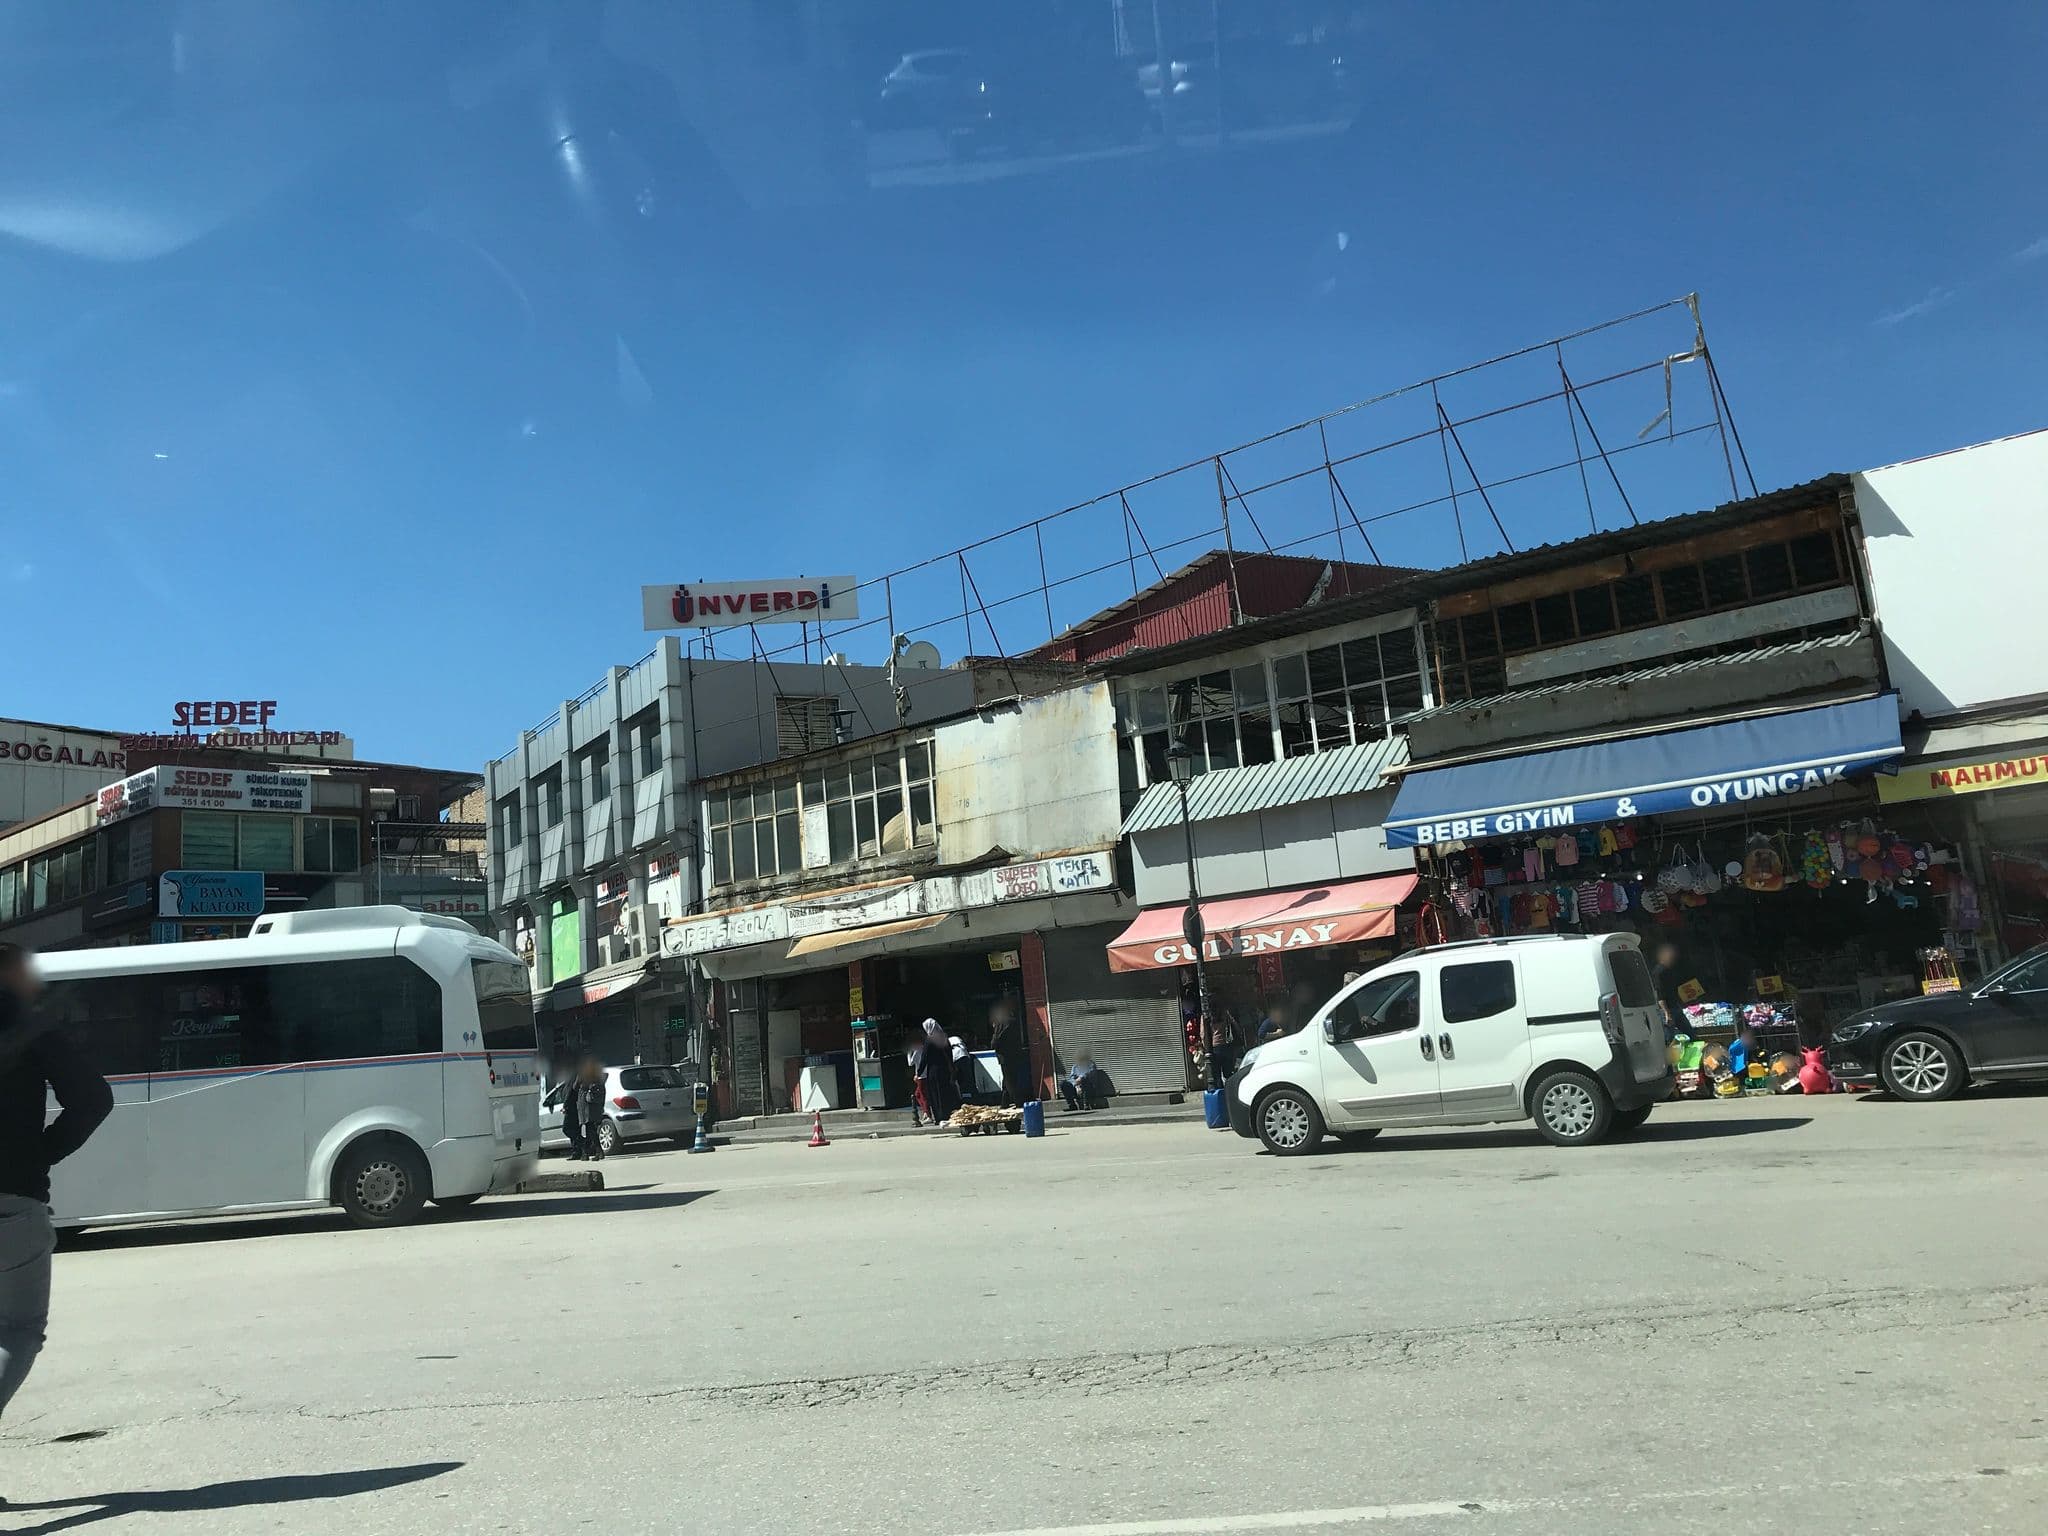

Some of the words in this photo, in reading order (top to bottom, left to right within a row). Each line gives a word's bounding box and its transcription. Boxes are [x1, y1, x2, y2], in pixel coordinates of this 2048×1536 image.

[172, 700, 278, 726] SEDEF
[119, 731, 199, 750] EĞİTİM
[206, 731, 340, 748] KURUMLARI
[174, 770, 233, 787] SEDEF
[246, 774, 279, 785] SÜRÜCÜ
[280, 776, 308, 786] KURSU
[164, 786, 199, 798] EĞİTİM
[201, 788, 243, 800] KURUMU
[250, 786, 303, 798] PSİKOTEKNİK
[181, 798, 197, 806] 351
[200, 799, 211, 807] 41
[1417, 818, 1488, 845] BEBE
[1616, 796, 1638, 817] &
[1691, 765, 1847, 808] OYUNCAK
[200, 887, 244, 898] BAYAN
